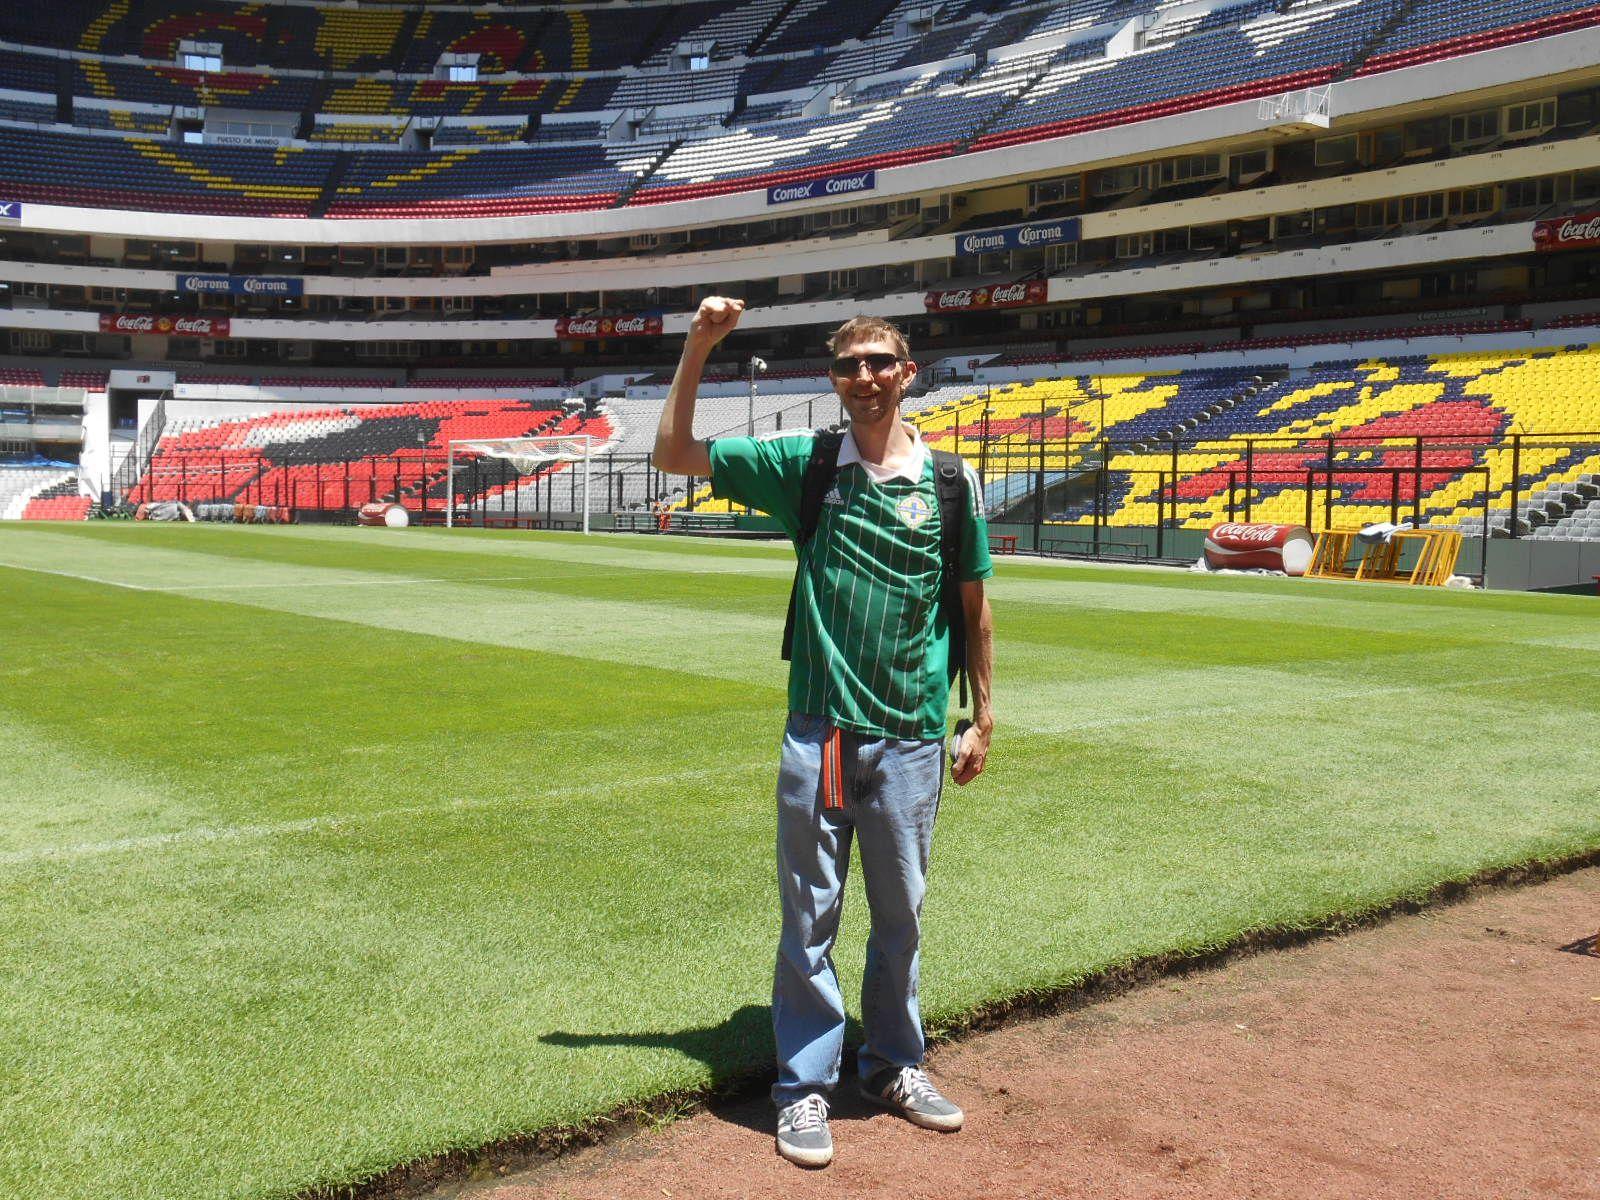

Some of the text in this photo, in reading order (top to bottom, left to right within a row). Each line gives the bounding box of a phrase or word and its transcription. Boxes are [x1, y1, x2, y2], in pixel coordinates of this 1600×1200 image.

[773, 172, 868, 202] Comex Comex
[963, 226, 1062, 253] Corona Corona
[185, 276, 288, 293] Corona Corona
